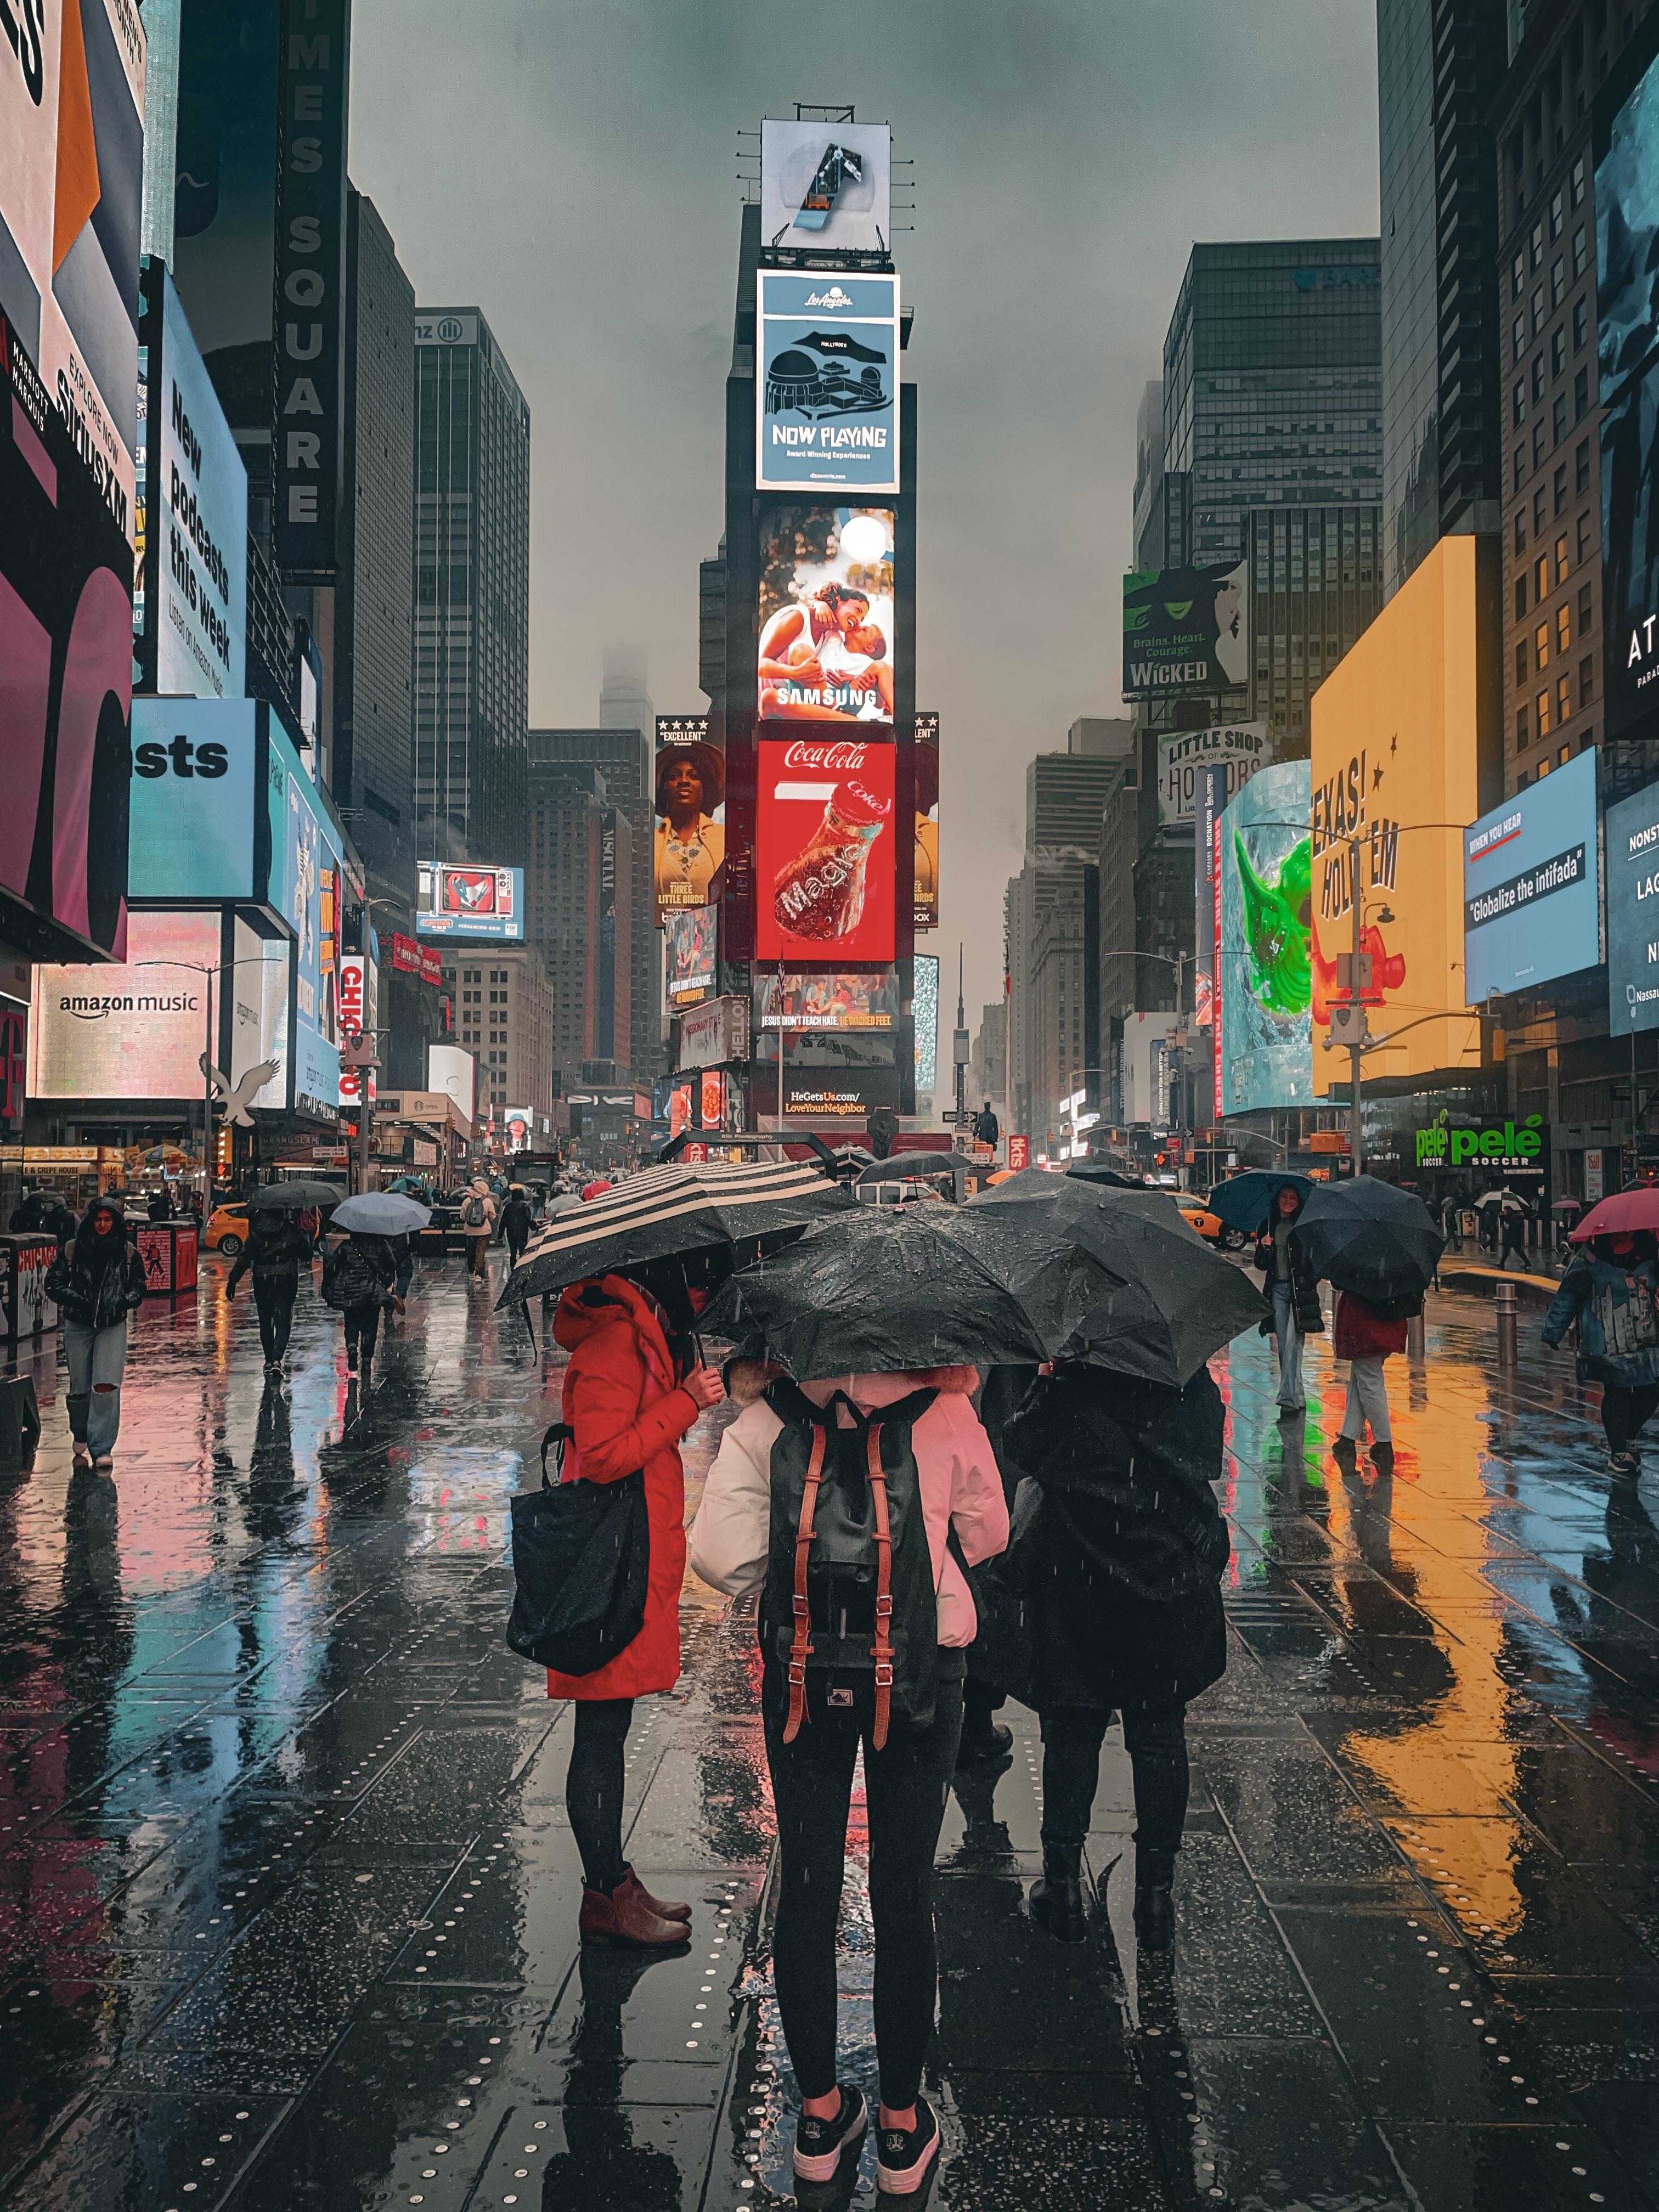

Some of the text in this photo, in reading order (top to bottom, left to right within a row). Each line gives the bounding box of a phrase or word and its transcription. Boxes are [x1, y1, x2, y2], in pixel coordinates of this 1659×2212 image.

[804, 292, 854, 309] Los Angeles
[13, 341, 49, 415] MARRIOTT
[283, 216, 325, 522] SQUARE
[12, 366, 44, 432] MARQUIS
[70, 352, 119, 465] EXPLORE NOW
[171, 380, 201, 483] New
[772, 424, 888, 448] NOW PLAYING
[786, 449, 871, 460] Award Winning Experiences
[171, 458, 230, 606] podcasts
[168, 593, 185, 637] Listen
[171, 527, 230, 673] this week
[1133, 633, 1206, 649] Brains. Heart.
[1146, 645, 1193, 658] Courage.
[777, 687, 877, 707] SAMSUNG
[134, 735, 229, 779] sts
[1169, 730, 1263, 765] LITTLE SHOP
[847, 780, 891, 815] Coke
[1311, 748, 1367, 861] EXAS!
[1469, 811, 1522, 855] WHEN YOU HEAR
[658, 894, 704, 904] LITTLE BIRDS
[669, 884, 693, 894] THREE
[1517, 879, 1534, 902] the
[60, 992, 199, 1011] amazon music
[732, 1000, 745, 1058] HELLO!
[761, 1015, 781, 1028] JESUS
[781, 1015, 802, 1026] DIDN'T
[802, 1015, 822, 1026] TEACH
[822, 1015, 839, 1026] HATE.
[839, 1015, 849, 1026] HE
[849, 1015, 875, 1026] WASHED
[785, 1103, 866, 1115] LoveYourNeighbor
[791, 1092, 861, 1103] HeGetsUs.com/
[1011, 1137, 1025, 1169] tkts
[1451, 1114, 1543, 1166] pelé
[1422, 1158, 1443, 1167] SOCCER
[1471, 1157, 1530, 1166] SOCCER
